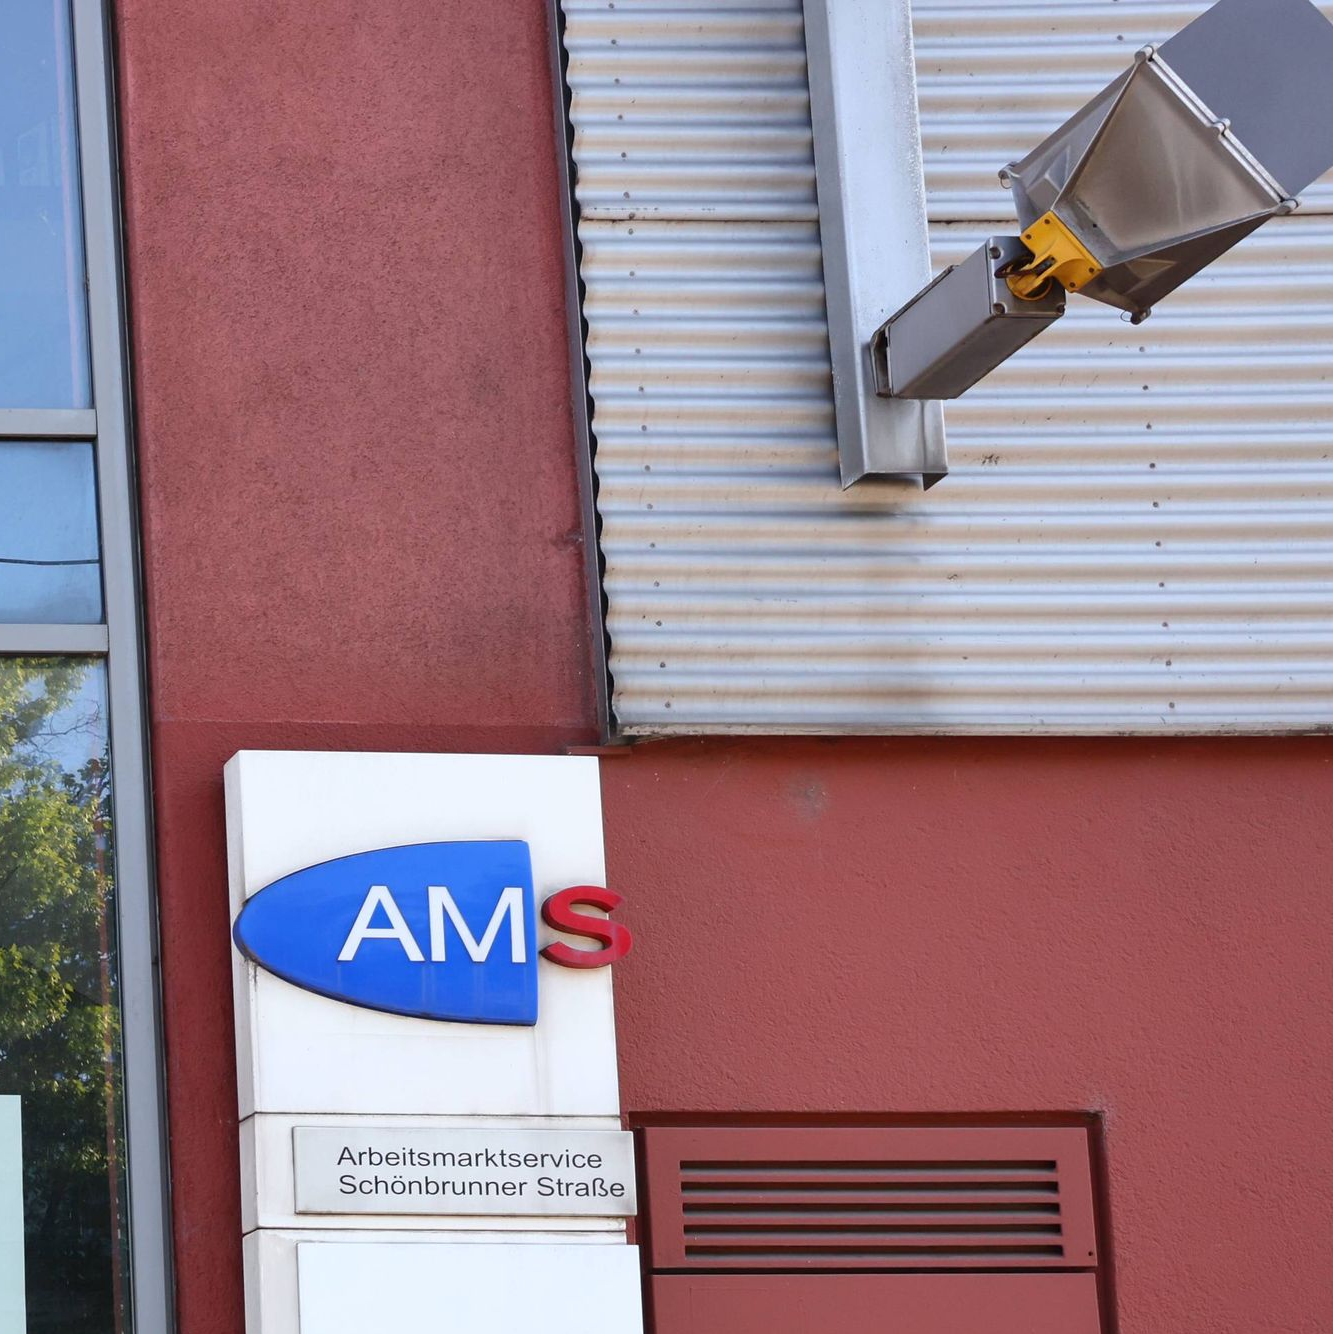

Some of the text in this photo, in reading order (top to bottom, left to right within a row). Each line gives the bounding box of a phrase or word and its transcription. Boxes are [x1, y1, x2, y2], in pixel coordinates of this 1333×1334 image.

[336, 885, 632, 970] AMS
[336, 1146, 602, 1169] Arbeitsmarktservice
[339, 1174, 625, 1197] Schönbrunner Straße
